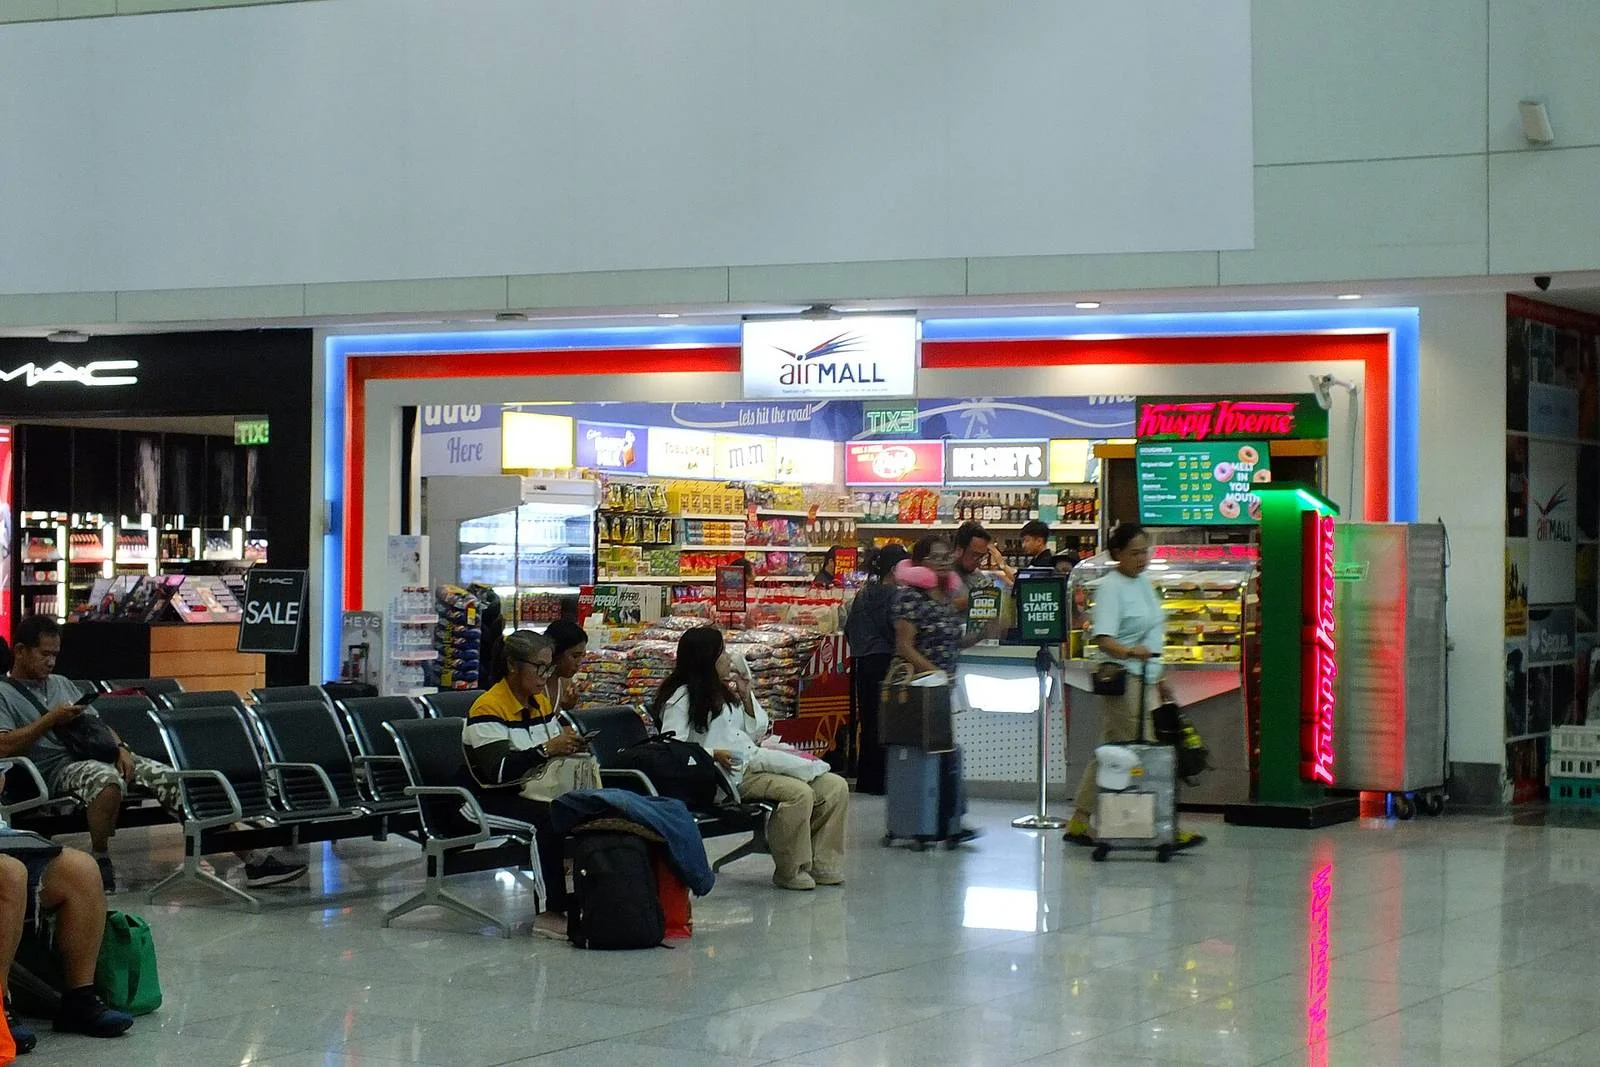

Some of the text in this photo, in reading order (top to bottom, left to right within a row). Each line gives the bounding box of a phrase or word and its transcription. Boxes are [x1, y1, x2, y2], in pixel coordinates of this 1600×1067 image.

[780, 355, 885, 385] airMALL
[756, 408, 769, 425] hit
[771, 406, 785, 424] the
[1137, 401, 1296, 441] Krispy Kreme
[447, 437, 484, 464] Here
[1236, 472, 1249, 482] IN
[1229, 482, 1250, 492] YOU
[1029, 592, 1052, 602] LINE
[245, 600, 299, 625] SALE
[1023, 602, 1059, 612] STARTS
[343, 616, 381, 629] HEYS
[1027, 612, 1055, 622] HERE
[1314, 514, 1337, 785] Krispy Kreme
